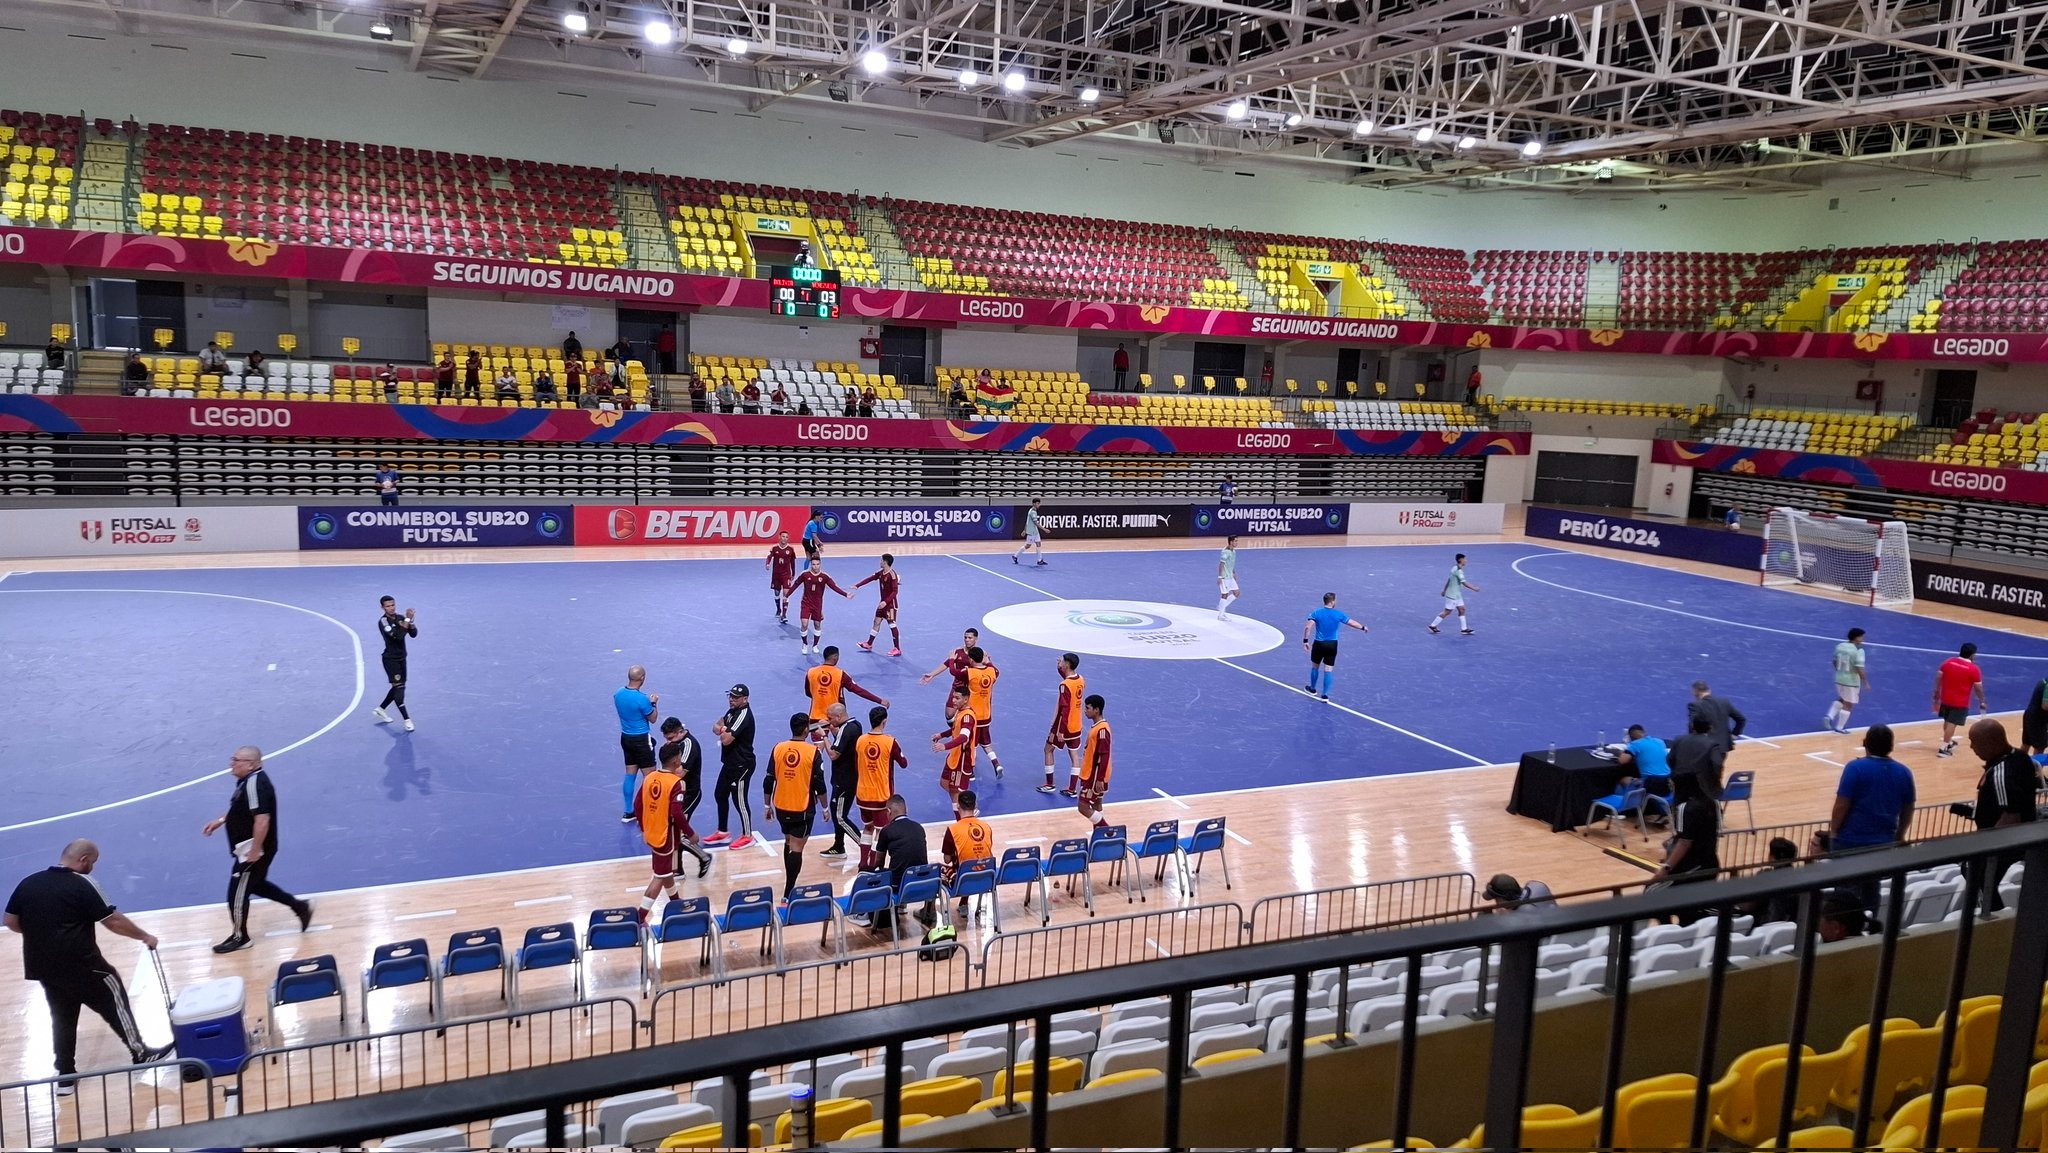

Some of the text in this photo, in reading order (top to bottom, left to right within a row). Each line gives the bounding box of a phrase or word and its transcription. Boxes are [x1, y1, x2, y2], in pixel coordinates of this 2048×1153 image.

[433, 261, 674, 296] SEGUIMOS JUGANDO
[780, 288, 795, 301] 00
[821, 290, 836, 303] 03
[831, 306, 839, 318] 2
[1251, 316, 1398, 339] SEGUIMOS JUGANDO
[346, 511, 529, 526] CONMEBOL SUB20
[847, 510, 981, 523] CONMEBOL SUB20
[1217, 508, 1323, 520] CONMEBOL SUB20
[1413, 510, 1444, 519] FUTSAL
[111, 517, 177, 531] FUTSAL
[644, 510, 780, 539] BETANO
[1082, 514, 1120, 528] FASTER.
[1121, 514, 1157, 528] PUMA
[1247, 521, 1292, 532] FUTSAL
[1412, 519, 1431, 528] PRO
[402, 528, 478, 543] FUTSAL
[887, 524, 943, 537] FUTSAL
[1559, 518, 1661, 548] PERÚ 2024
[111, 531, 151, 544] PRO
[1927, 573, 2047, 608] FOREVER. FASTER.
